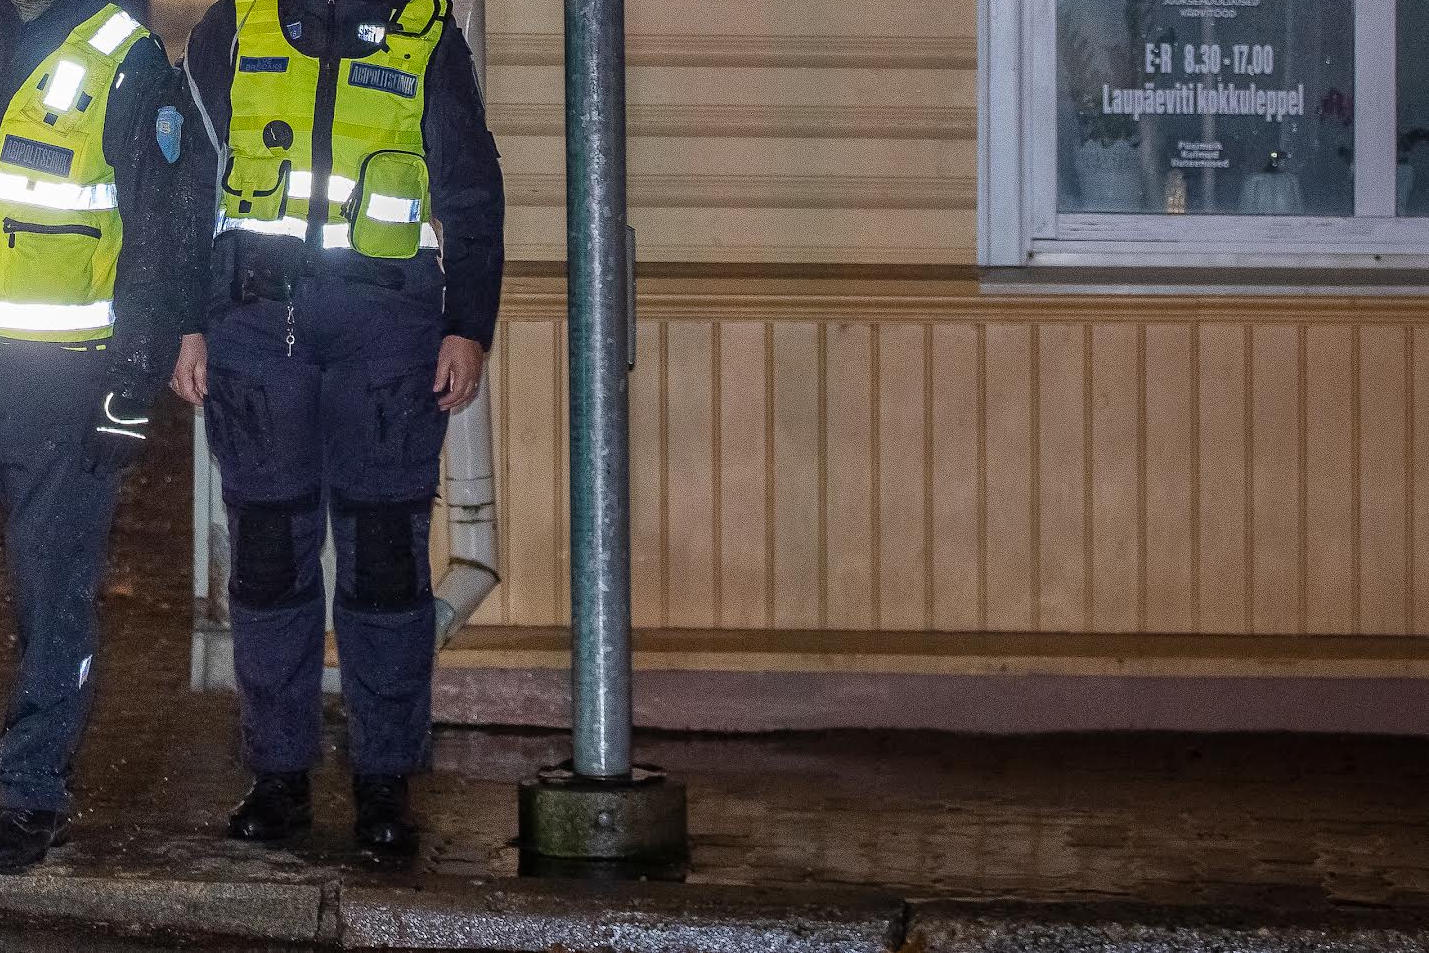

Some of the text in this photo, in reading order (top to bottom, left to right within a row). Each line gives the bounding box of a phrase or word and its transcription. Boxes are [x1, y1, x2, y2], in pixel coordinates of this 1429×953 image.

[1184, 44, 1220, 74] 8.30
[1233, 45, 1274, 75] 17.00
[351, 65, 416, 95] ABIPOLITSEINIK
[1102, 83, 1305, 123] Laupäeviti kokkuleppel
[5, 139, 69, 174] ABIPOLITSEINIK
